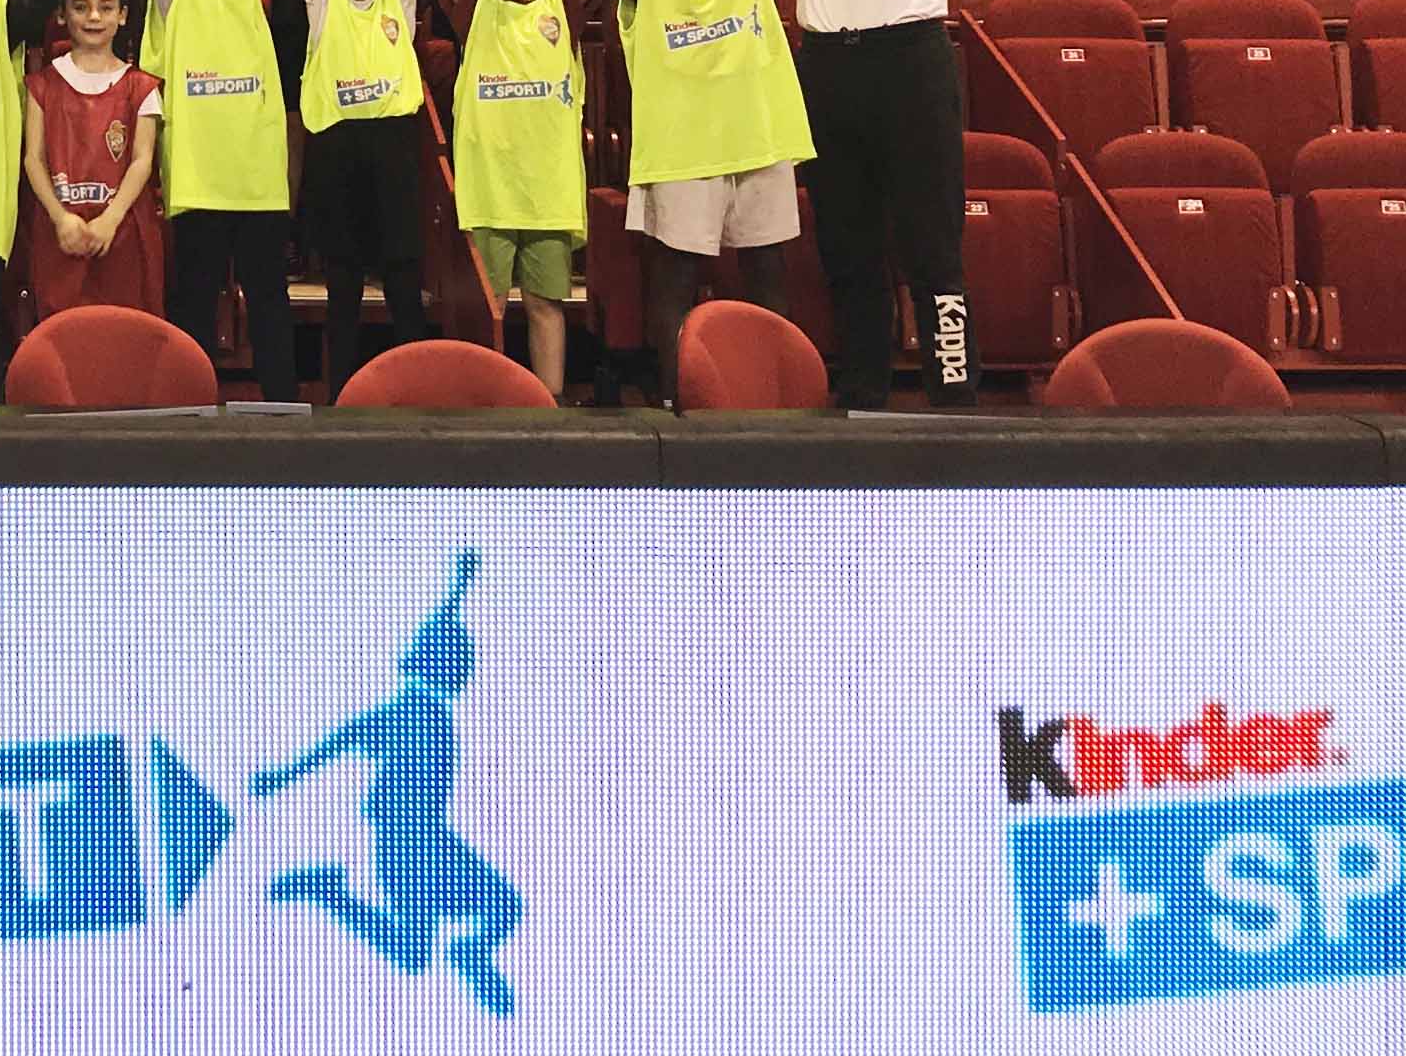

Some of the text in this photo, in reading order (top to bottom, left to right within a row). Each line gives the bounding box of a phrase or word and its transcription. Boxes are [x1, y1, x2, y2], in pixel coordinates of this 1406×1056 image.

[687, 19, 732, 44] SPORT
[205, 78, 252, 94] SPORT
[496, 83, 542, 97] SPORT
[934, 294, 968, 384] Kappa
